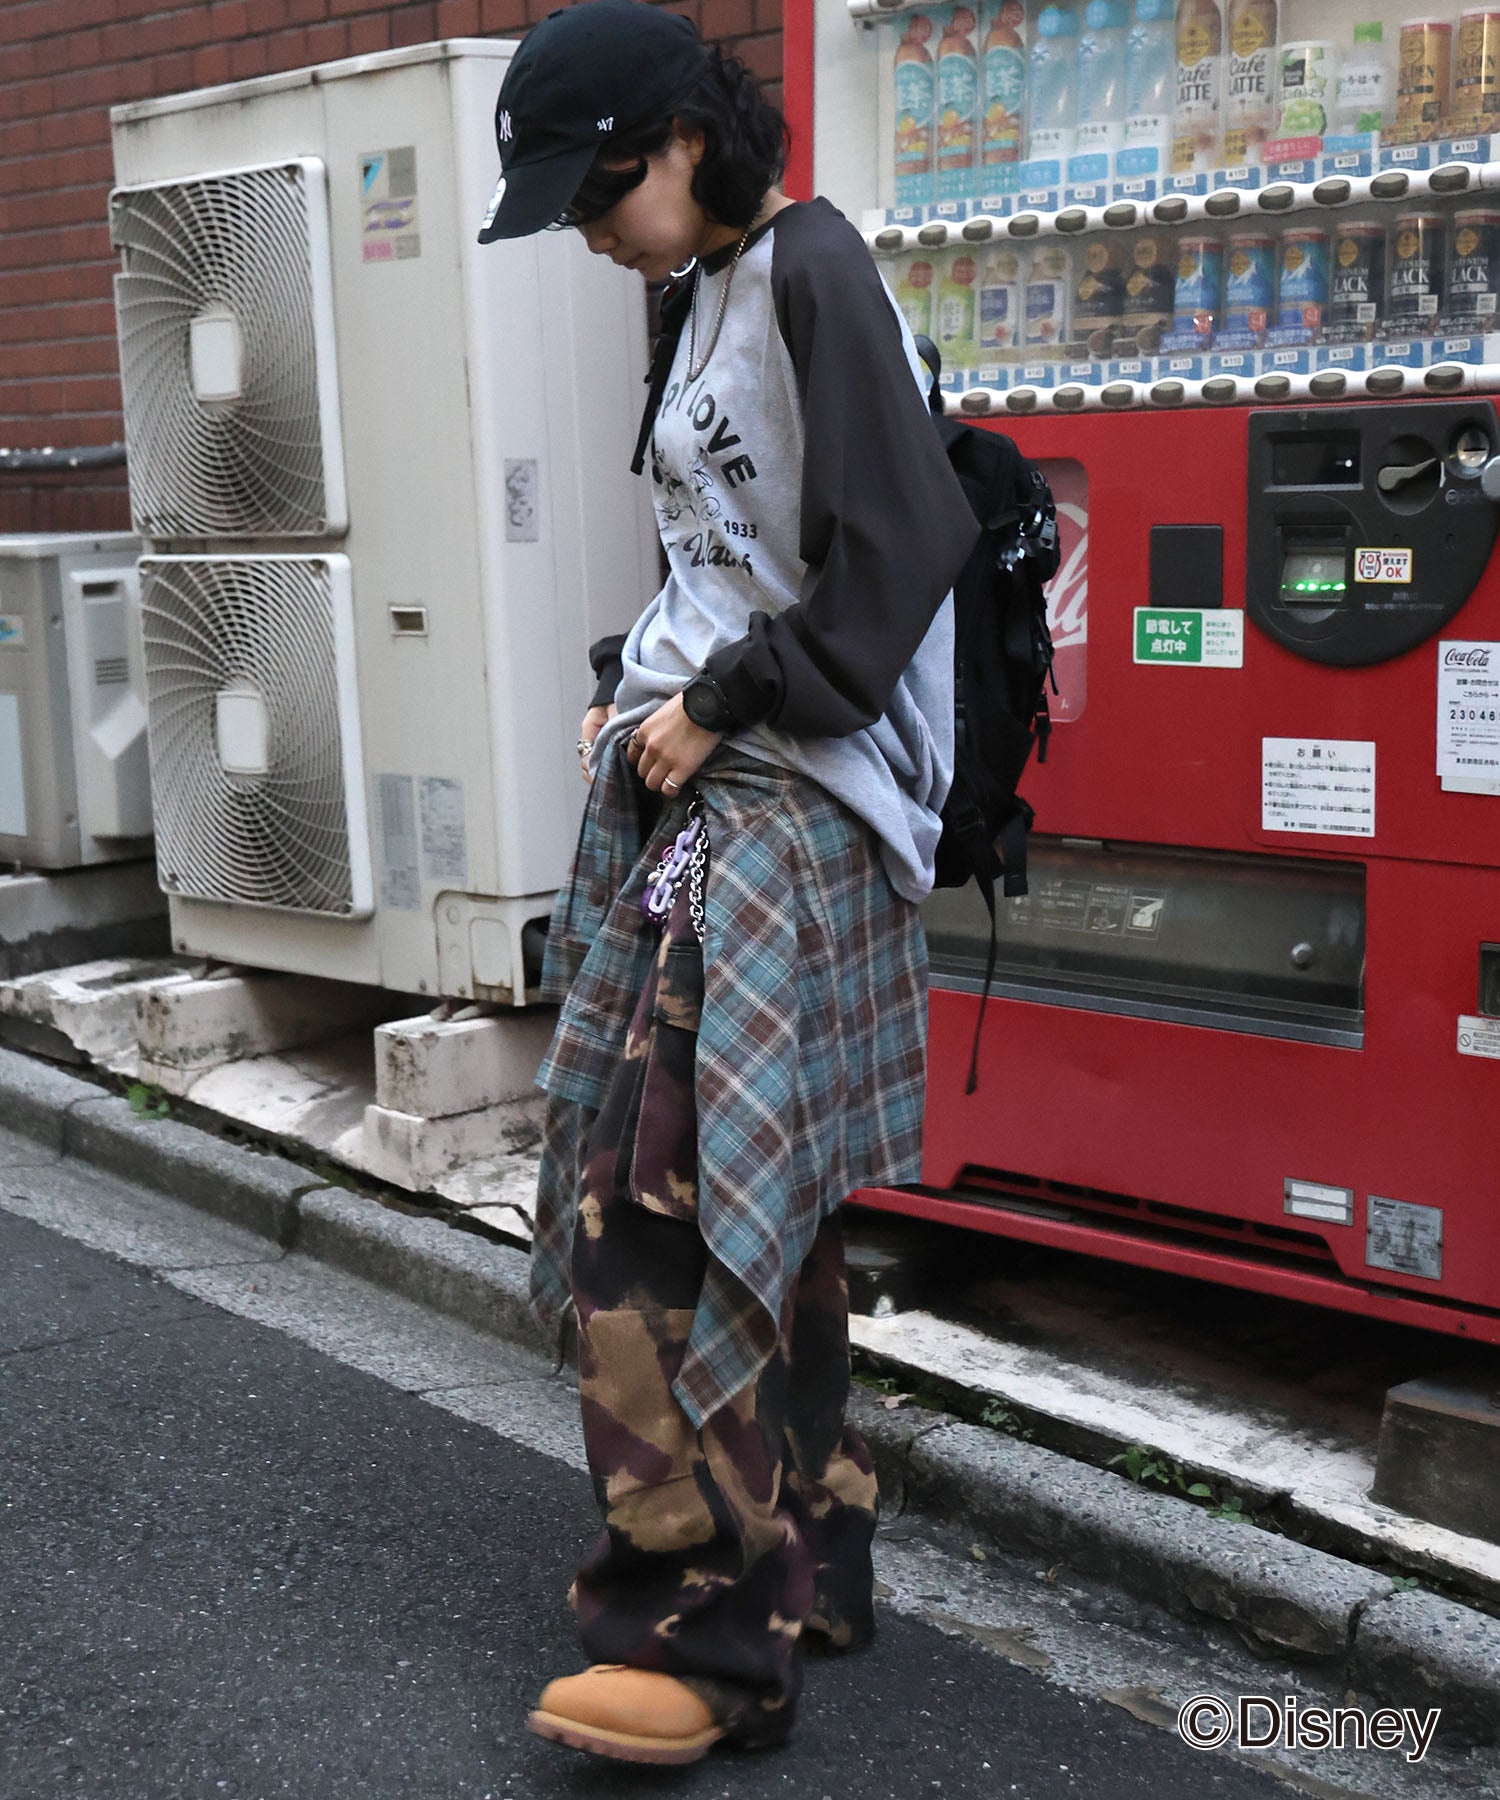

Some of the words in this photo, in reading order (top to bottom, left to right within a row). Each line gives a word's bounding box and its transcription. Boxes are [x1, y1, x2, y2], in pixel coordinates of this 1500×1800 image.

[1451, 265, 1488, 283] LACK
[1334, 276, 1368, 293] LACK
[723, 519, 758, 539] 1933
[1383, 557, 1408, 565] 使えます
[1386, 566, 1402, 578] OK
[1145, 618, 1193, 635] 節電して
[1150, 639, 1187, 655] 点灯中
[1450, 709, 1500, 721] 23046
